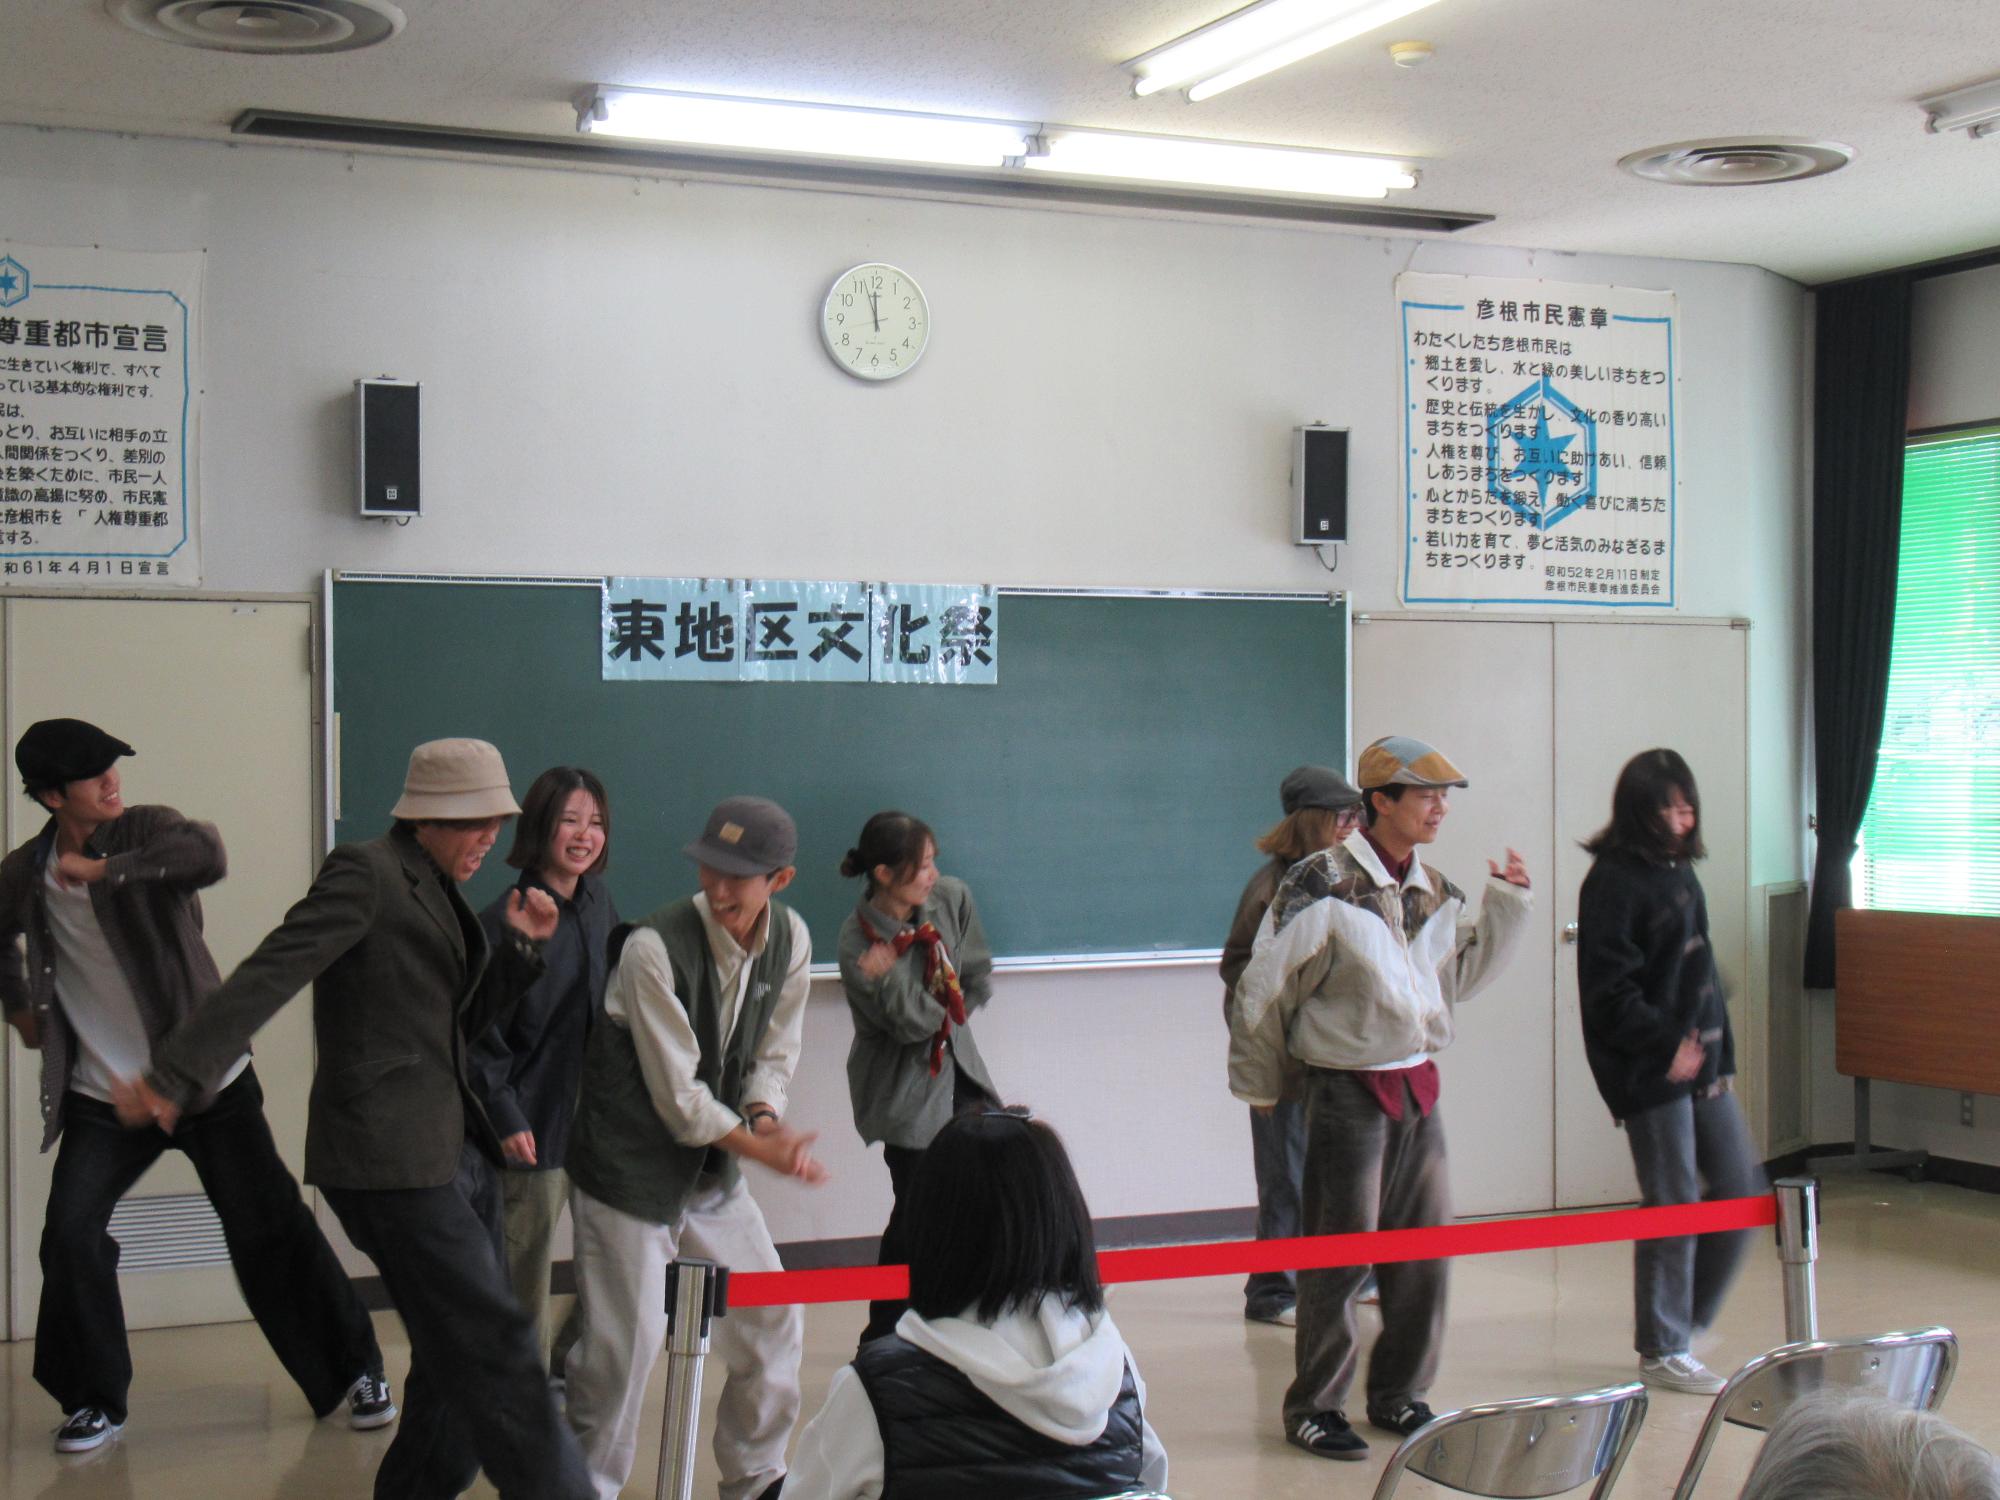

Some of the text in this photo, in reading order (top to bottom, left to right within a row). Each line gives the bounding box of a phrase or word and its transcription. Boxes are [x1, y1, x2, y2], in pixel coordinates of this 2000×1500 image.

[854, 280, 863, 294] 11
[871, 276, 883, 289] 12
[842, 293, 854, 307] 10
[903, 296, 911, 309] 2
[836, 313, 845, 325] 9
[1477, 298, 1608, 329] 彦根市民憲章
[908, 317, 917, 330] 3
[0, 316, 168, 352] 尊重都市宣言
[841, 332, 850, 345] 8
[902, 337, 909, 349] 4
[1414, 330, 1572, 356] わたくしたち彦根市民は
[856, 347, 863, 360] 7
[870, 353, 879, 367] 6
[889, 348, 898, 361] 5
[607, 599, 993, 666] 東地区文化祭
